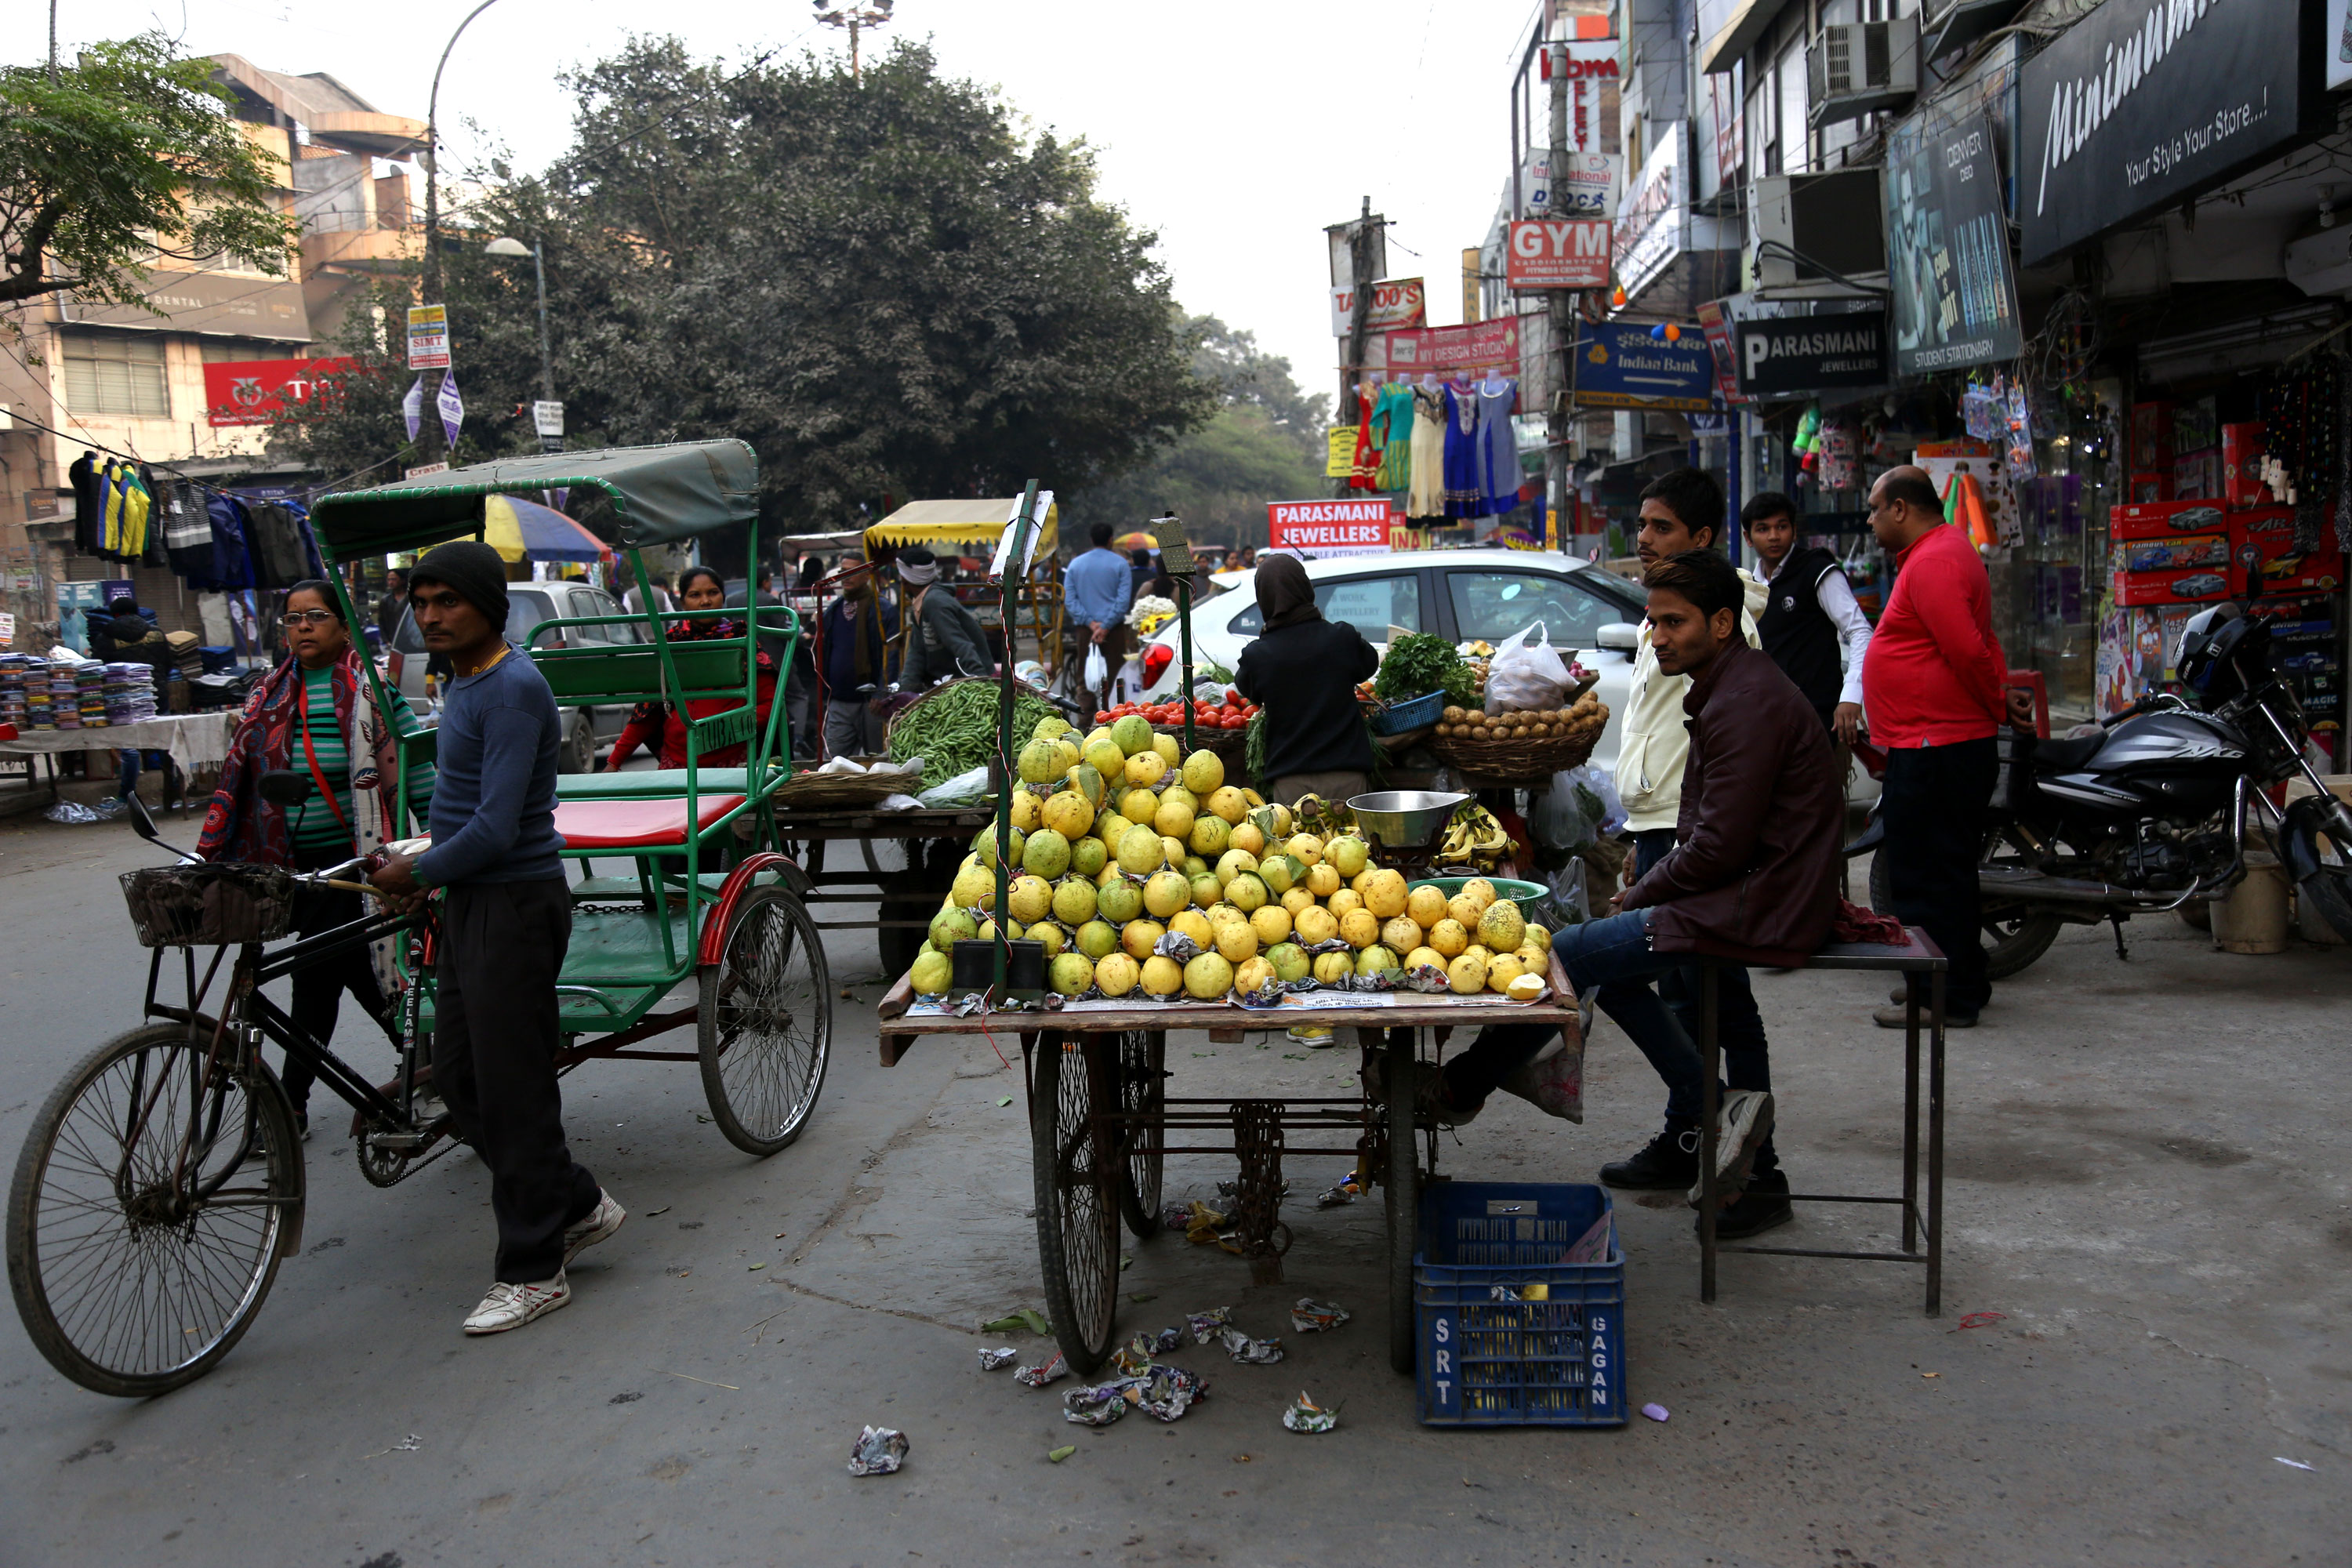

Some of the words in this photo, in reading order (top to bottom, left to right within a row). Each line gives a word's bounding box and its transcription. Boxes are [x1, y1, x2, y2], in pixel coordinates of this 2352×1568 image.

[1947, 131, 1982, 168] DENVER
[2125, 156, 2150, 187] Your
[2152, 137, 2182, 176] Style
[2183, 122, 2212, 157] Your
[1533, 165, 1612, 182] Intational
[1514, 223, 1608, 258] GYM
[1934, 247, 1951, 279] COOL
[154, 296, 203, 308] DENTAL
[1335, 285, 1419, 313] TAOO'S
[1940, 290, 1959, 332] HOT
[413, 336, 443, 348] SIMT
[1419, 349, 1433, 363] MY
[1435, 344, 1470, 362] DESIGN
[1472, 340, 1507, 358] STUDIO
[1915, 346, 1946, 368] STUDENT
[1947, 339, 1994, 363] STATIONARY
[1618, 354, 1661, 368] Indian
[1664, 358, 1699, 373] Bank
[1819, 358, 1878, 373] JEWELLERS
[409, 464, 445, 477] Crash
[1276, 504, 1385, 523] PARASMANI
[1280, 526, 1381, 544] JEWELLERS
[2303, 695, 2338, 705] MAGIC
[403, 978, 416, 1037] NEELAM
[1436, 1318, 1450, 1404] SRT
[1591, 1317, 1606, 1404] GAGAN
